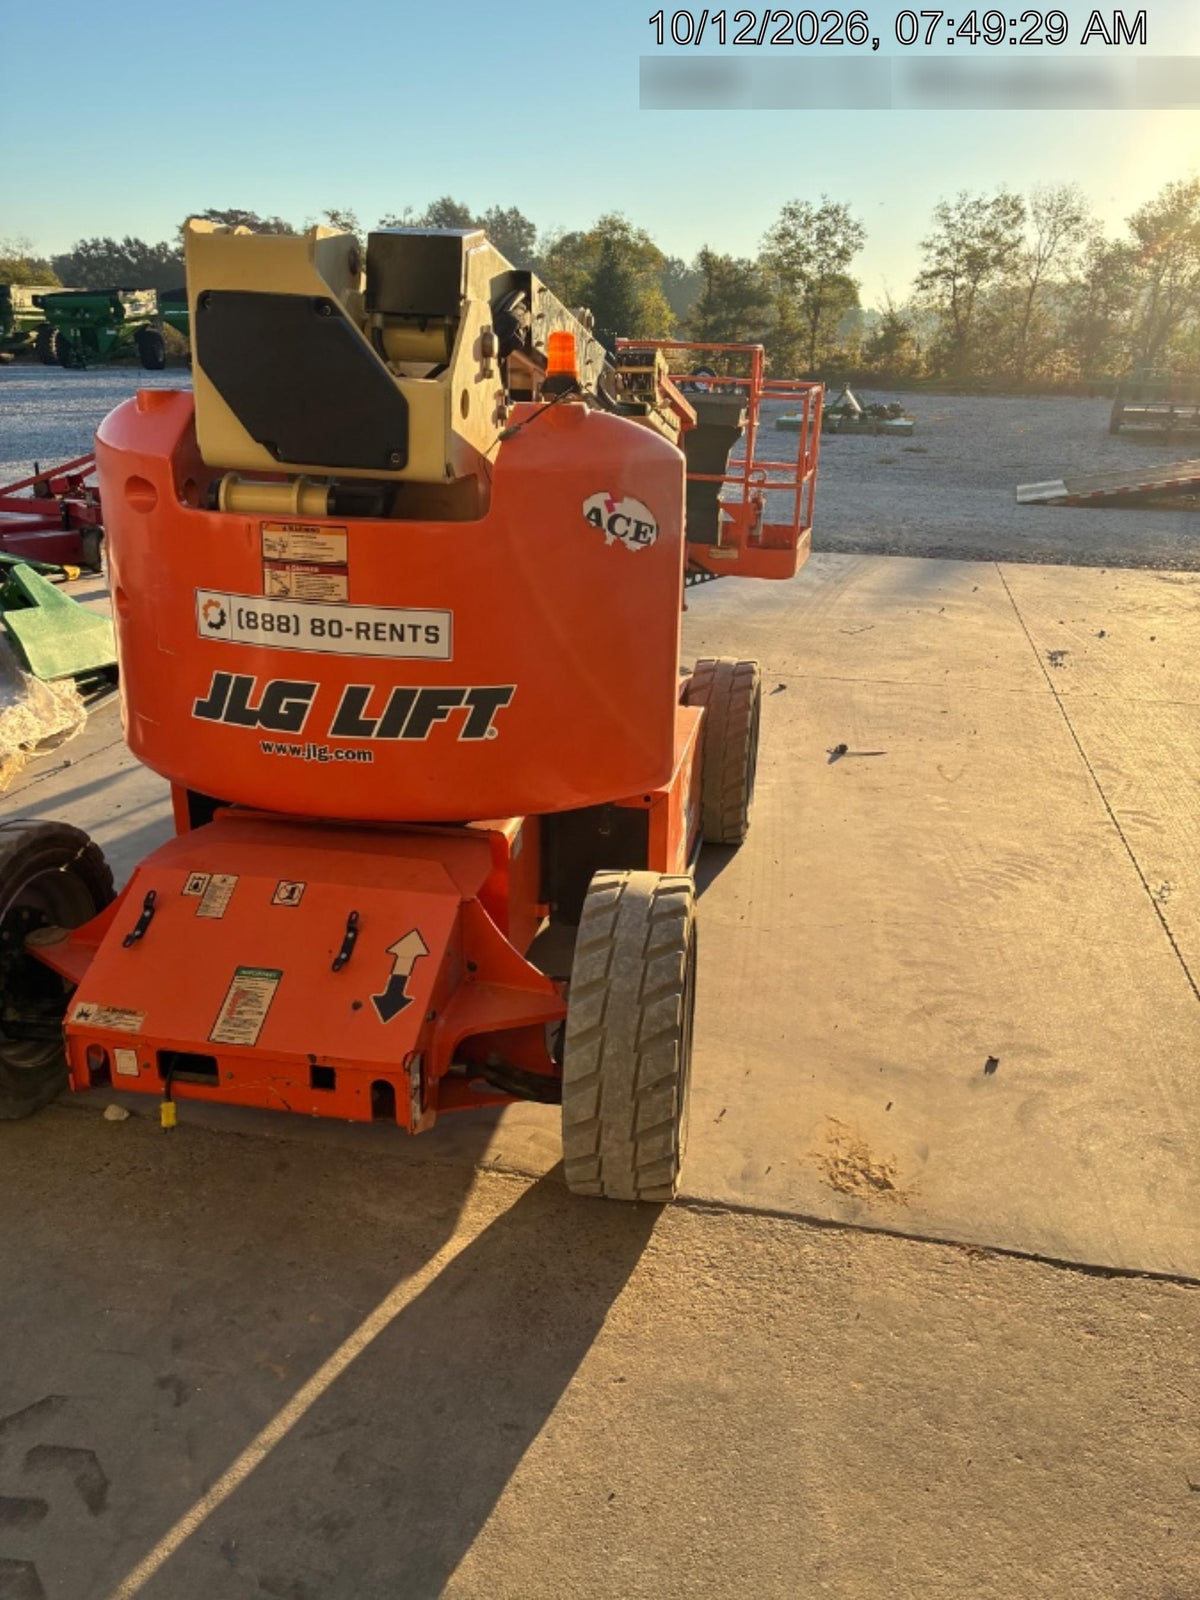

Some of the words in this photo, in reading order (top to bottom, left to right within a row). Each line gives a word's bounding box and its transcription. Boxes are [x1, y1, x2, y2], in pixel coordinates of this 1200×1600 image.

[587, 506, 654, 544] ACE
[236, 607, 300, 636] (888)
[310, 617, 440, 645] 80-RENTS
[192, 671, 320, 734] JLG
[327, 685, 517, 741] LIFT
[261, 740, 373, 763] www.jlg.com
